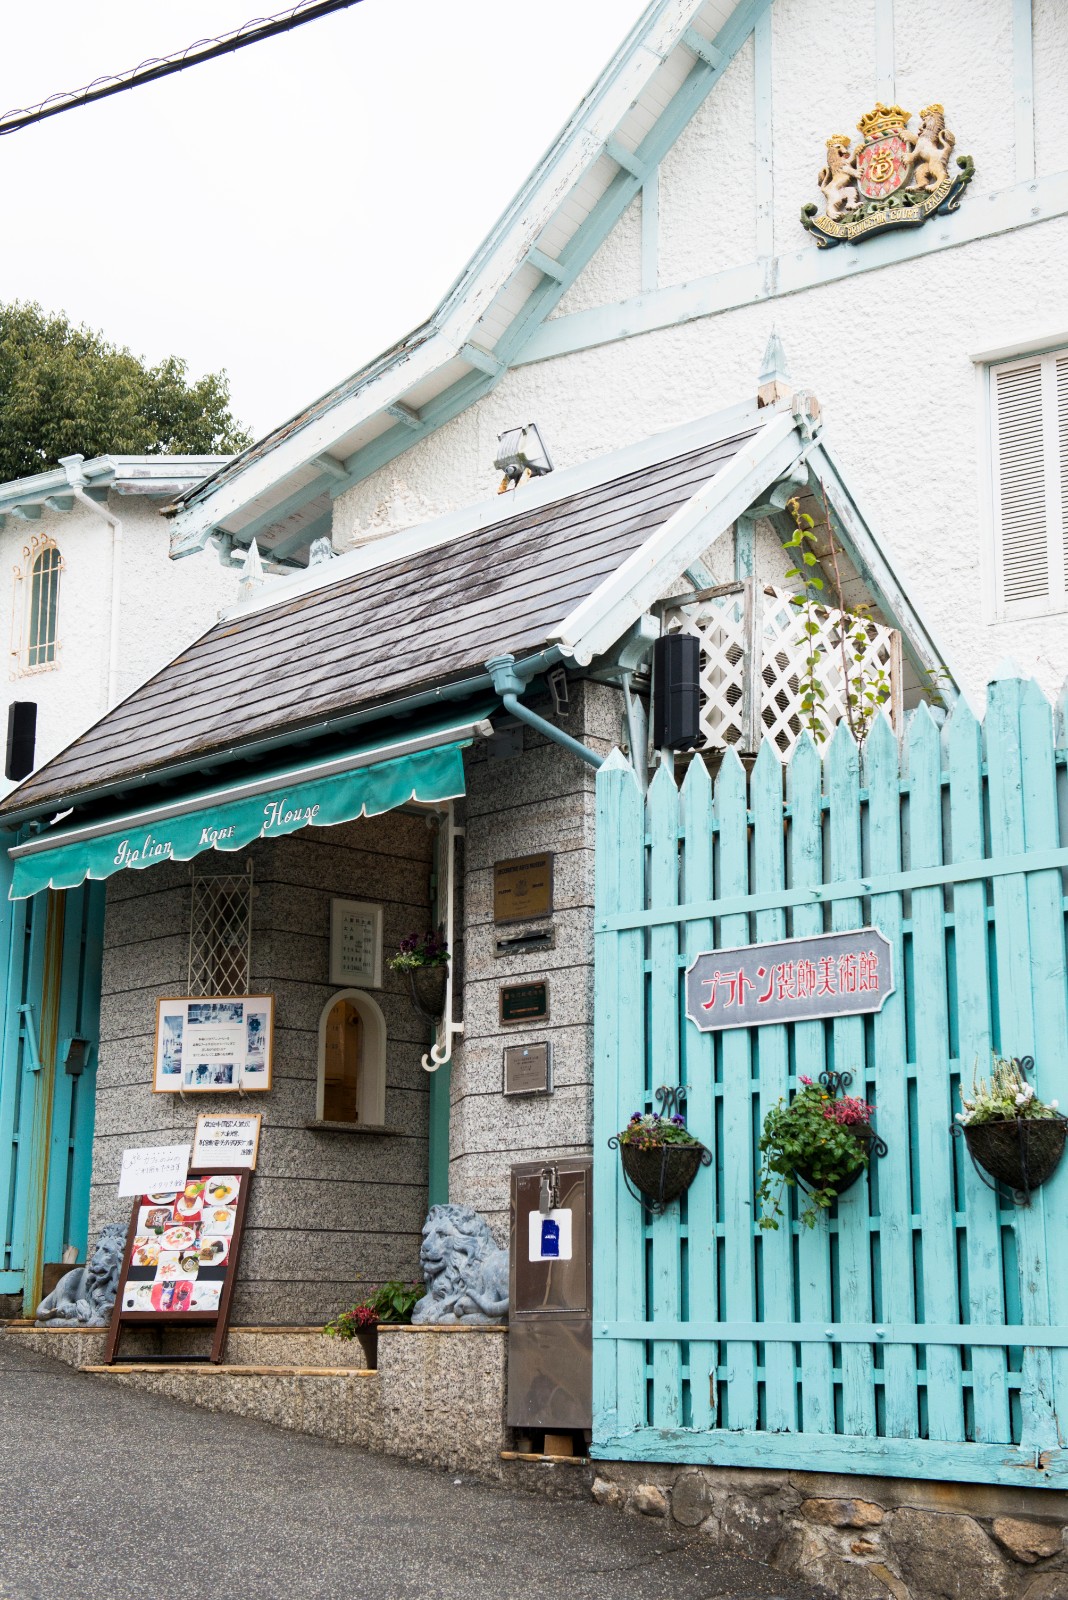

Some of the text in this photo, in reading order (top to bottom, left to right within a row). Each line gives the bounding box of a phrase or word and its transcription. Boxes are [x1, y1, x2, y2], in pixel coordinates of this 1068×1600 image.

[890, 208, 919, 221] COURT
[113, 798, 320, 865] Italian KOBE House
[701, 951, 880, 1011] プラトン装飾美術館
